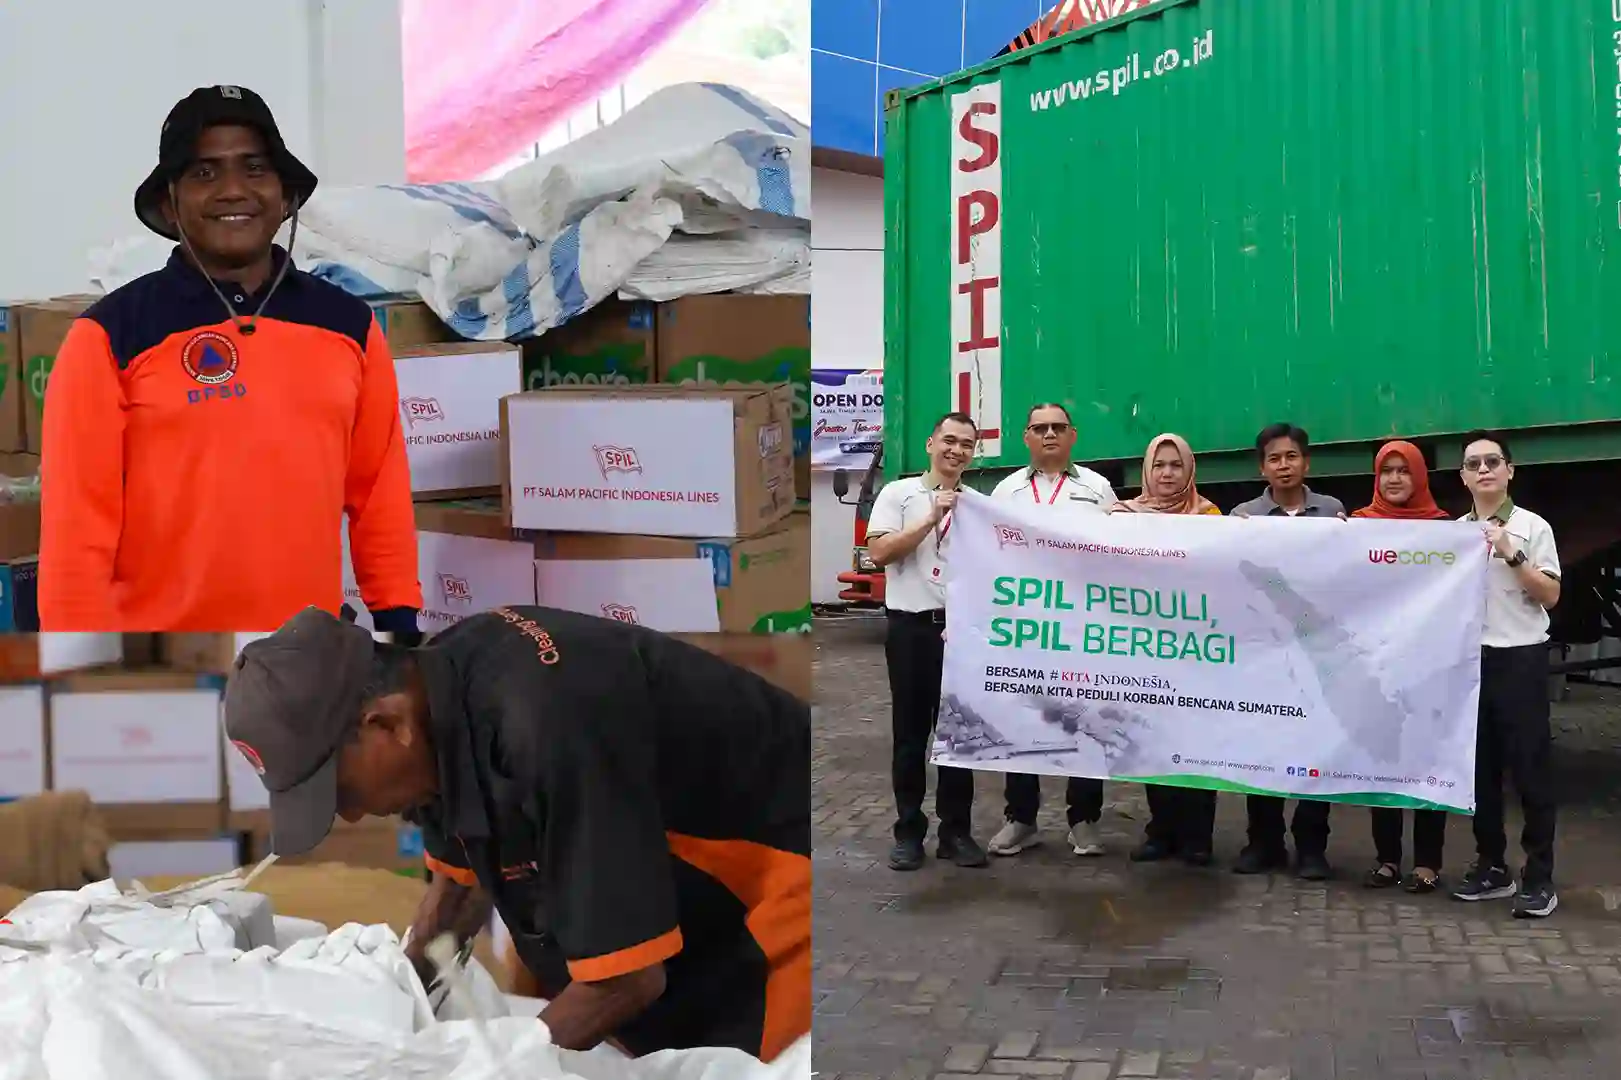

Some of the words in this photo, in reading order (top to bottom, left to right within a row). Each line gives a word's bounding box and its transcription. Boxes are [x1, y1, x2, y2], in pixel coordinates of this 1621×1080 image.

[1029, 30, 1214, 113] www.spil.co.id
[812, 393, 857, 408] OPEN
[411, 403, 438, 415] SPIL
[426, 431, 482, 445] INDONESIA
[605, 451, 635, 467] SPIL
[523, 487, 537, 499] PT
[538, 487, 576, 499] SALAM
[578, 488, 619, 500] PACIFIC
[621, 489, 684, 502] INDONESIA
[687, 491, 720, 503] LINES
[1002, 529, 1024, 542] SPIL
[1036, 539, 1046, 548] PT
[1048, 540, 1076, 550] SALAM
[1078, 543, 1109, 554] PACIFIC
[1111, 546, 1160, 557] INDONESIA
[1162, 550, 1187, 559] LINES
[446, 579, 467, 594] SPIL
[992, 576, 1075, 610] SPIL
[1086, 583, 1219, 629] PEDULI,
[988, 618, 1071, 652] SPIL
[1083, 623, 1235, 665] BERBAGI
[985, 665, 1045, 681] BERSAMA
[984, 681, 1044, 697] BERSAMA
[1047, 686, 1074, 699] KITA
[1076, 688, 1120, 702] PEDULI
[1123, 691, 1175, 706] KORBAN
[1177, 696, 1235, 712] BENCANA
[1237, 701, 1307, 719] SUMATERA.
